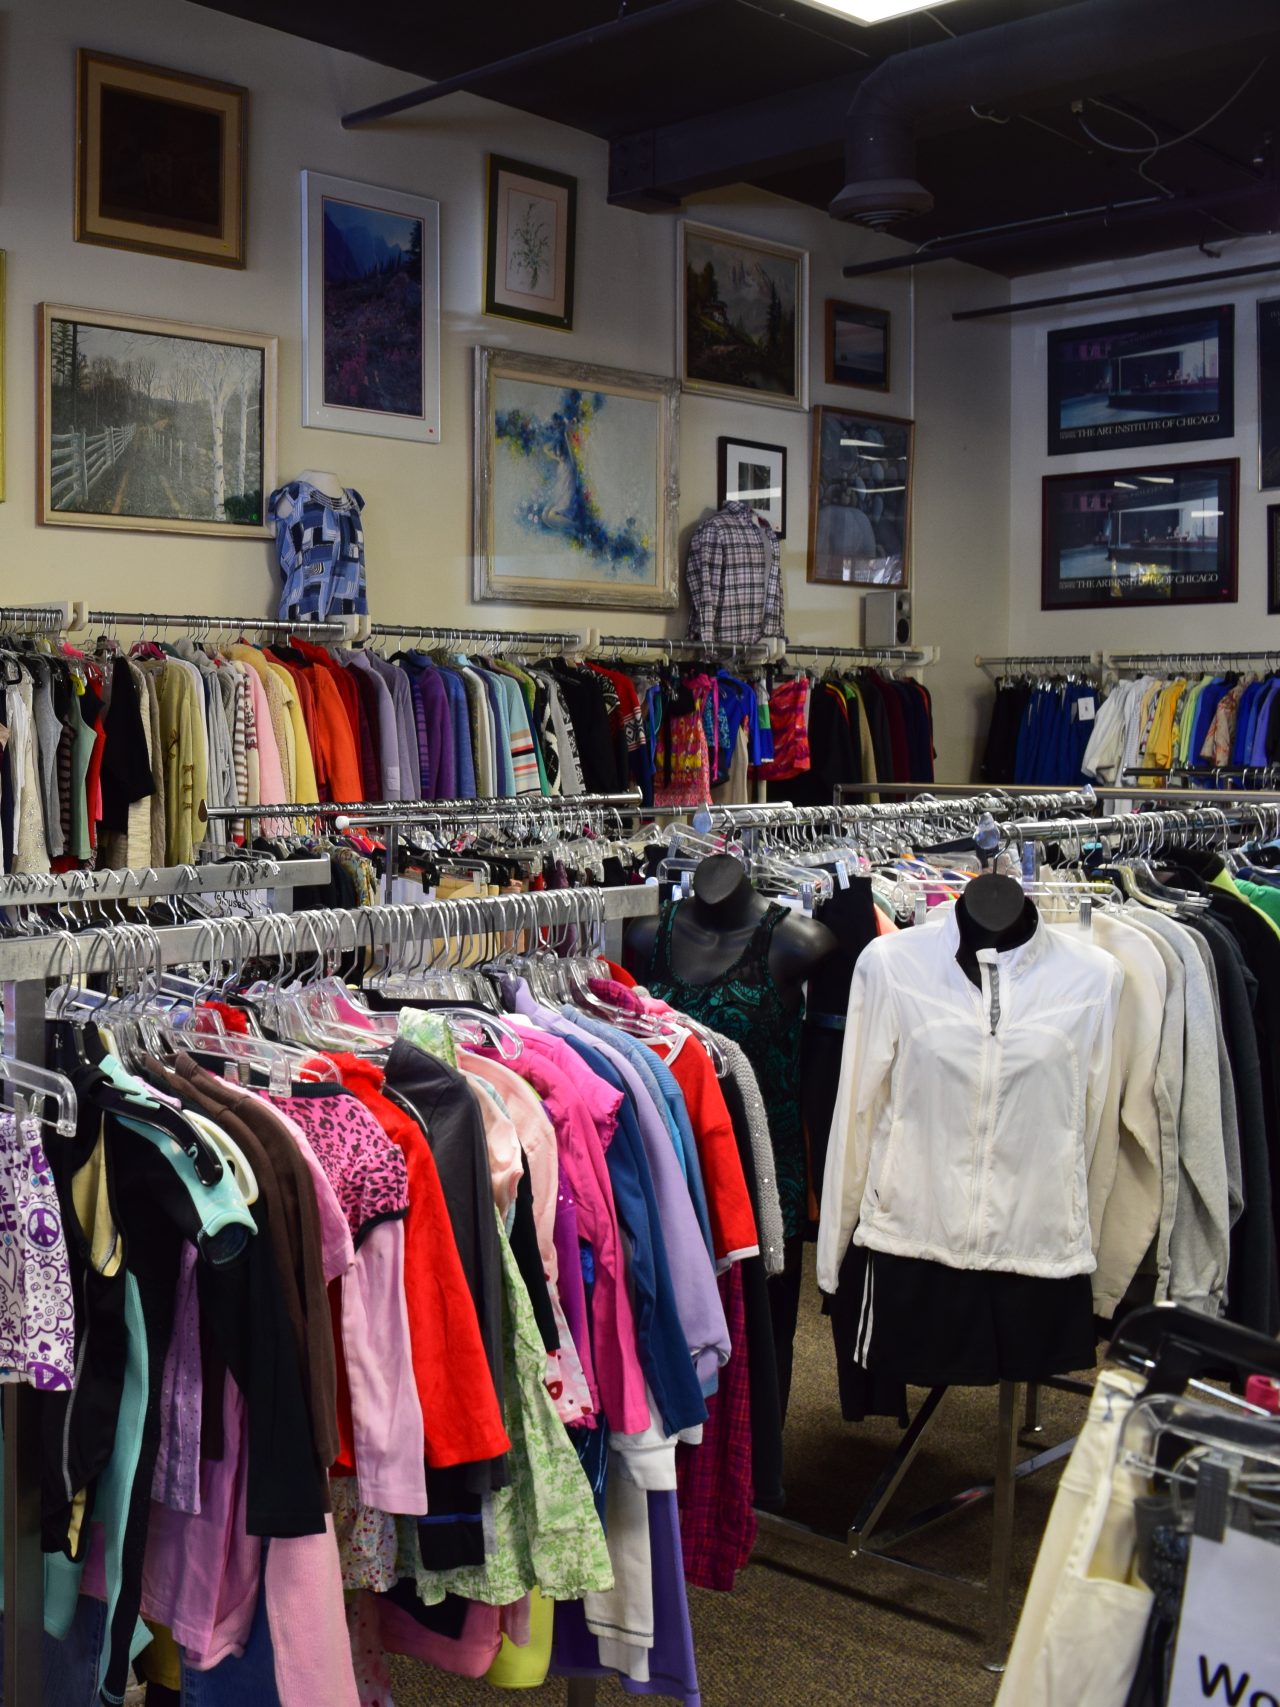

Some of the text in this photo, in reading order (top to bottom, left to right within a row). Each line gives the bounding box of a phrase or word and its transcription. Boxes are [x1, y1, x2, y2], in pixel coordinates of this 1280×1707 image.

[1077, 429, 1096, 439] THE
[1096, 426, 1114, 436] ART
[1115, 422, 1161, 433] INSTITUTE
[1162, 419, 1176, 429] OF
[1176, 414, 1220, 427] CHICAGO
[1076, 580, 1096, 589] THE
[1096, 579, 1112, 588] ART
[1175, 572, 1218, 584] CHICAGO
